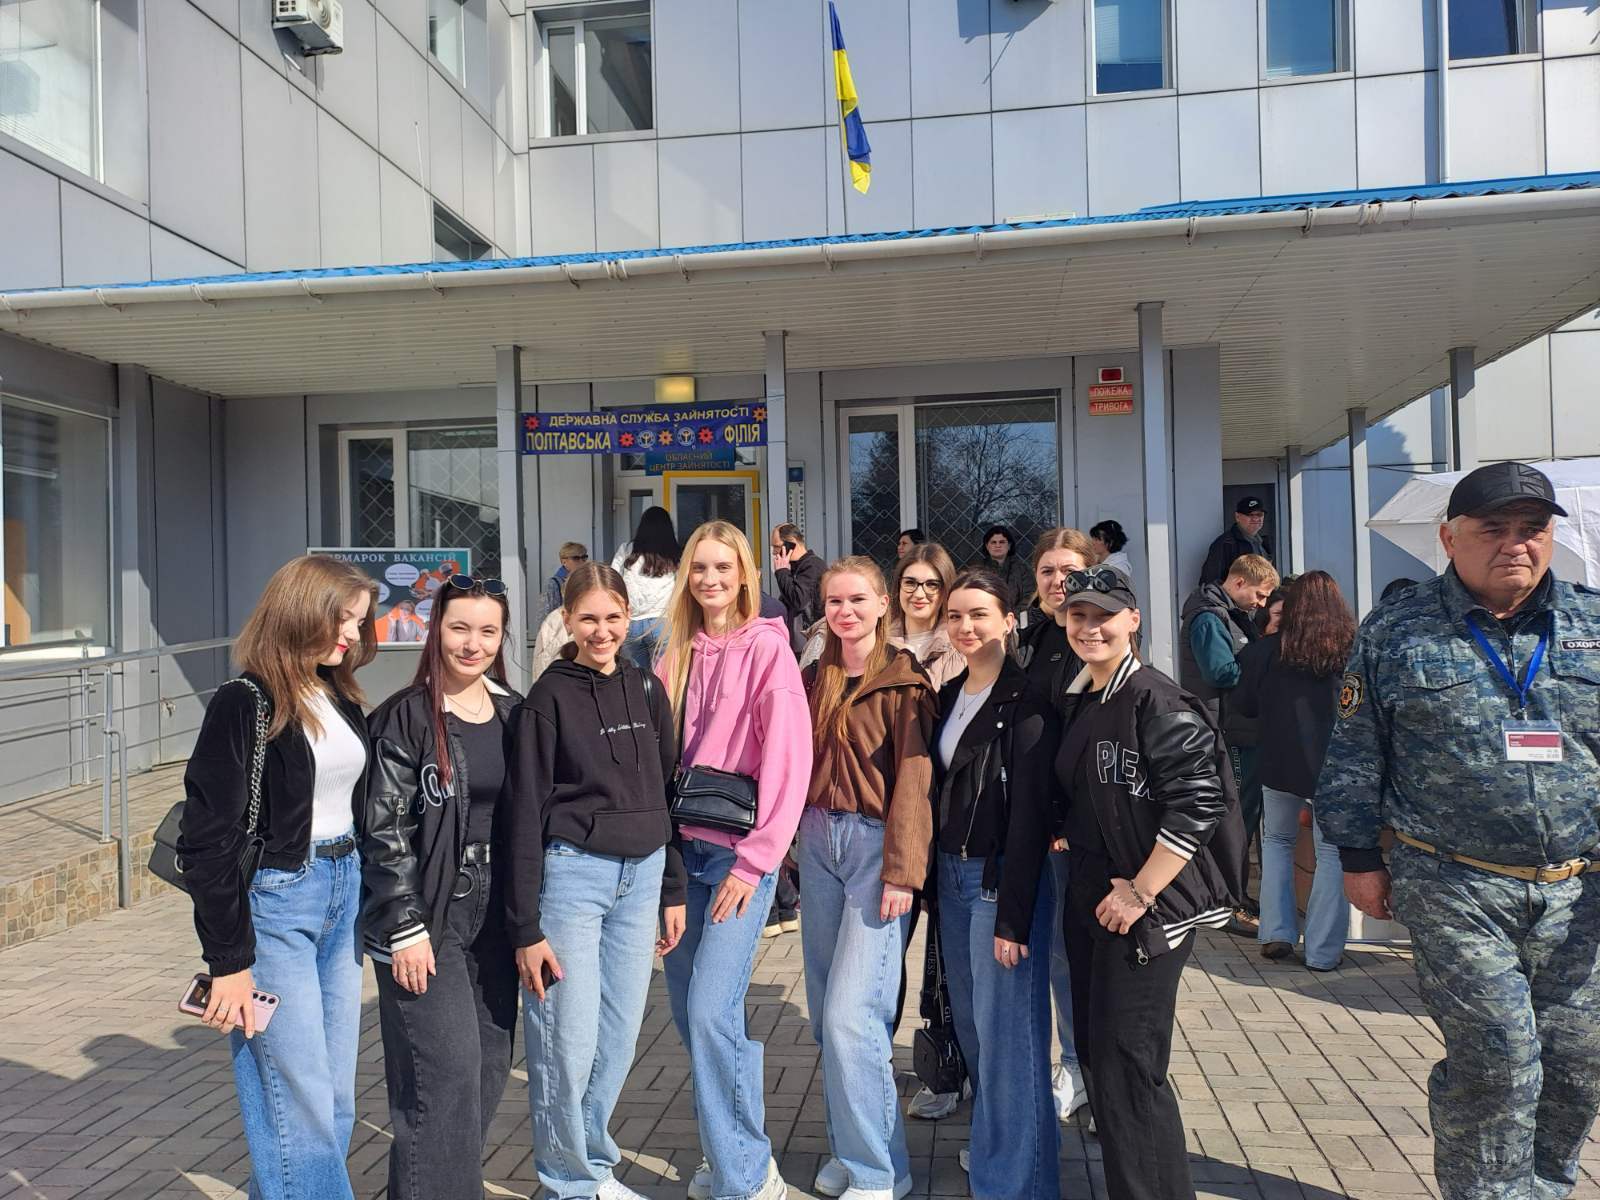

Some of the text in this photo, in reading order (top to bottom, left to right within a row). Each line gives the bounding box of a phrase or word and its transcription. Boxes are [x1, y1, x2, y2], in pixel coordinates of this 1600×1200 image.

[1094, 386, 1129, 397] ПОЖЕЖА
[1094, 401, 1129, 412] ТРИВОГА
[549, 406, 750, 428] ДЕРЖАВНА СЛУЖБА ЗАЙНЯТОСТІ
[526, 423, 761, 451] ПОЛТАВСЬКА ФІЛІЯ
[329, 552, 457, 563] РМАРОК ВАКАНСІЙ
